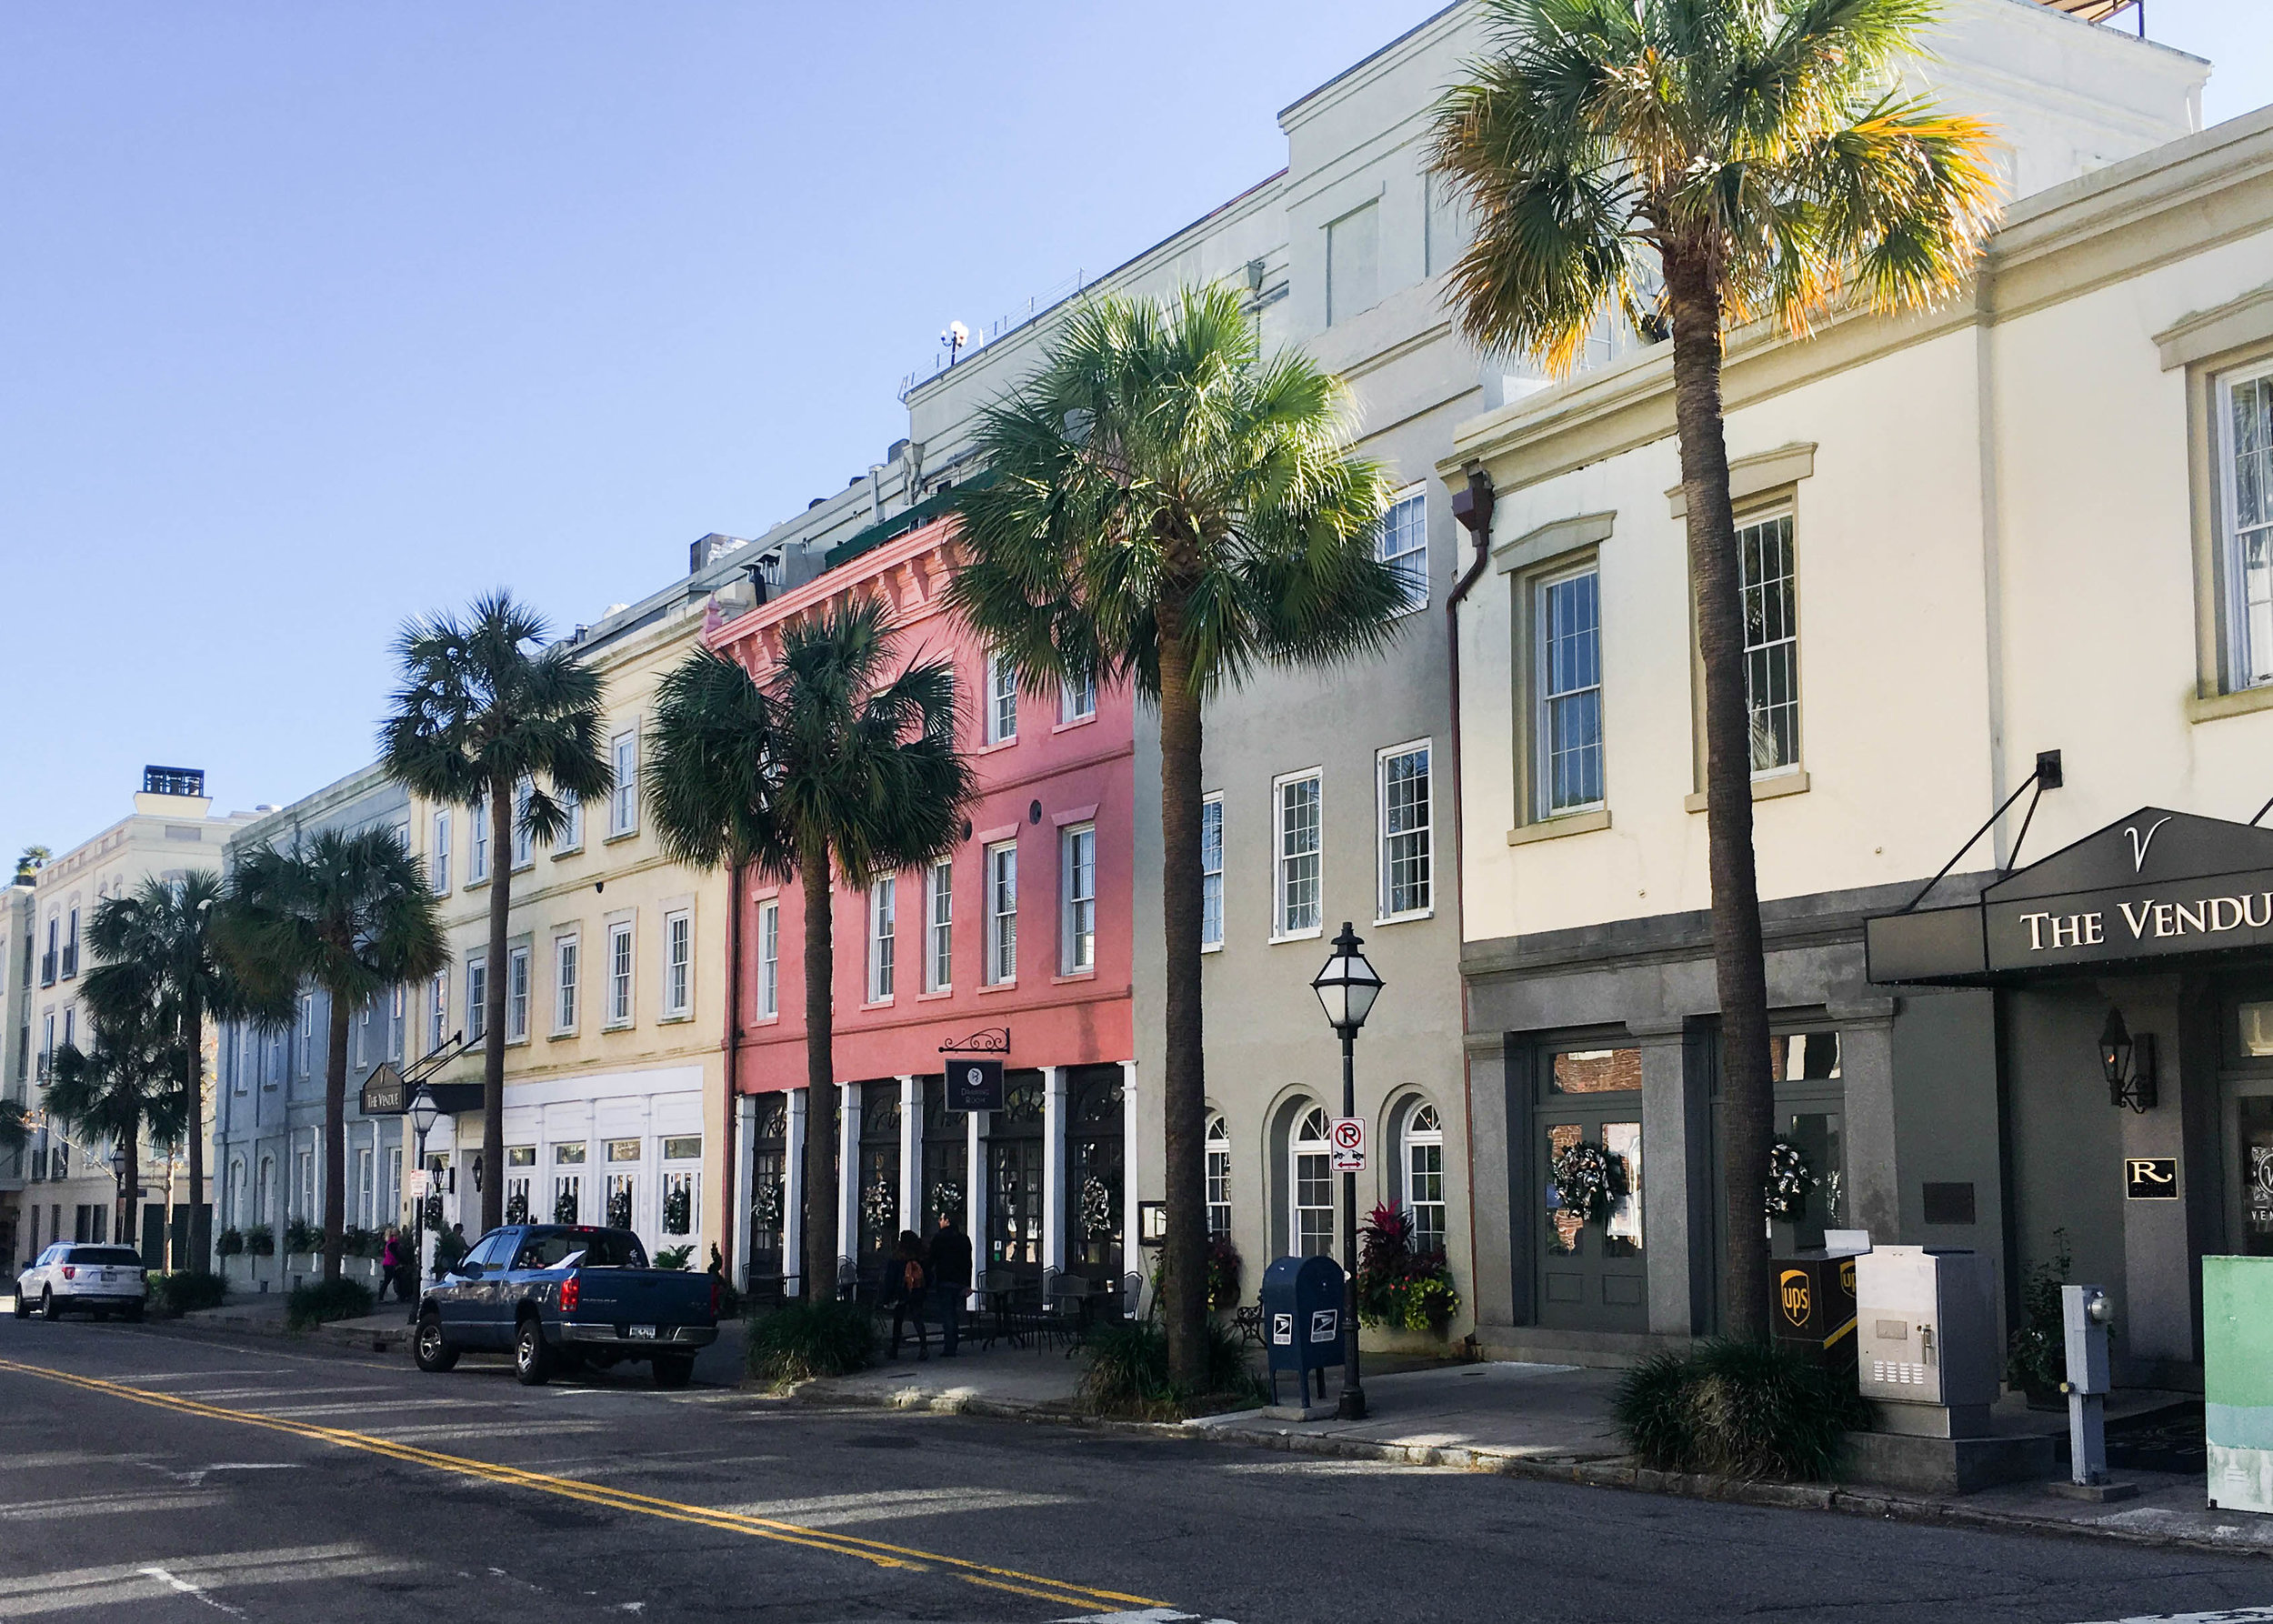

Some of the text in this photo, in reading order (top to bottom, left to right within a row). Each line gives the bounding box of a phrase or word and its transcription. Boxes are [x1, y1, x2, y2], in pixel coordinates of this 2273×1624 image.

[2124, 817, 2172, 873] V
[2019, 891, 2273, 951] THE VENDU
[367, 1094, 378, 1108] THE
[2130, 1161, 2173, 1183] R
[1842, 1272, 1857, 1293] up
[1783, 1287, 1808, 1318] ups
